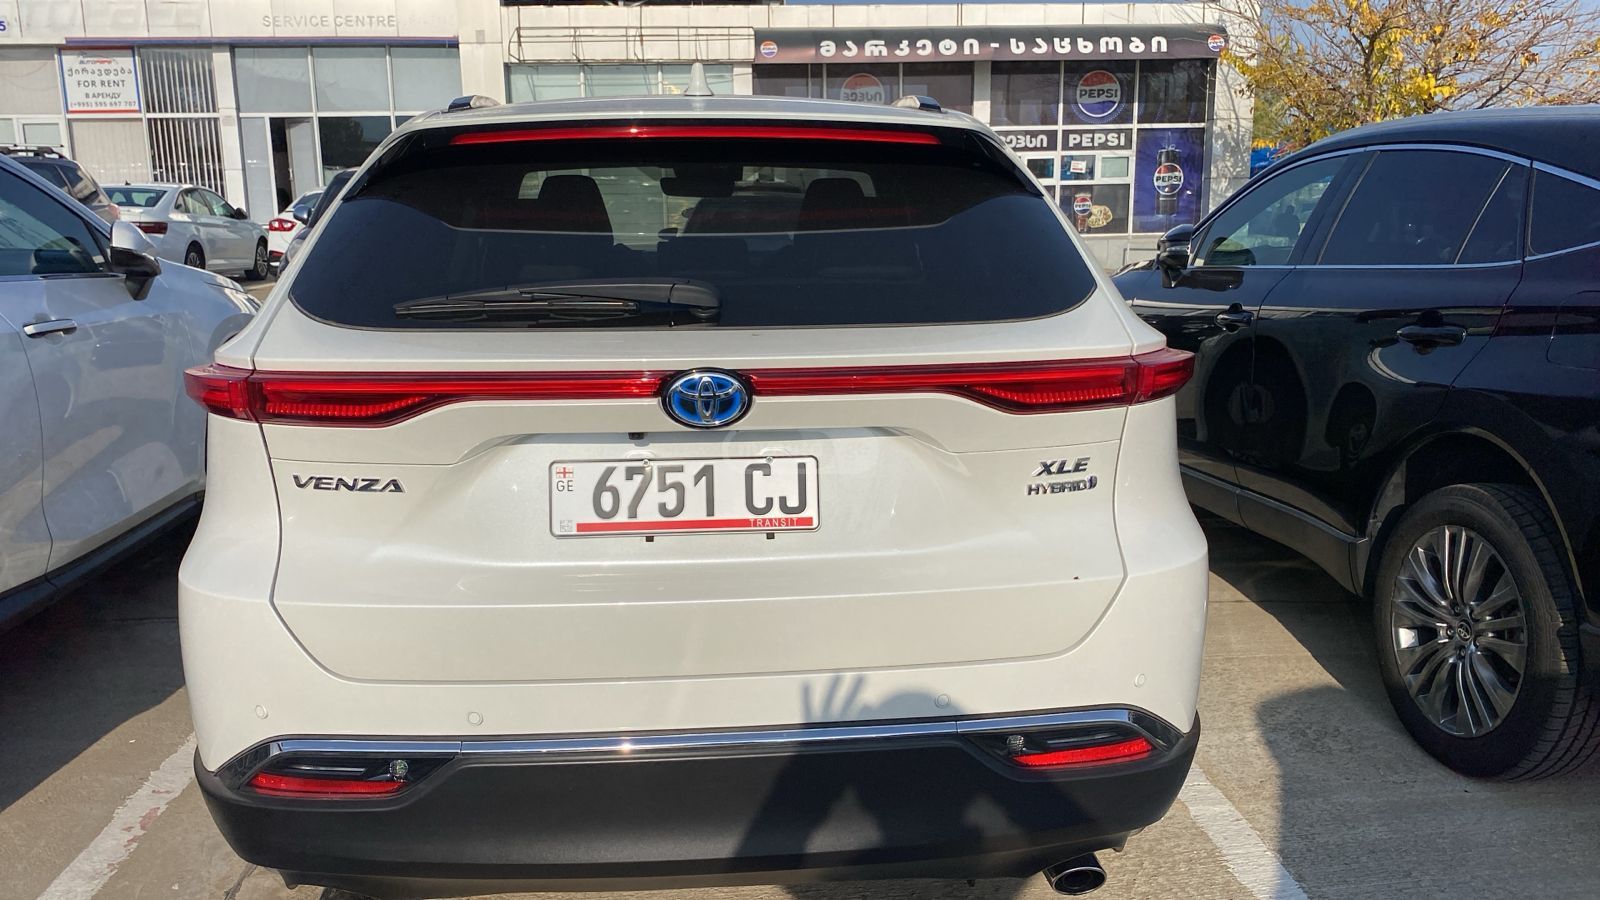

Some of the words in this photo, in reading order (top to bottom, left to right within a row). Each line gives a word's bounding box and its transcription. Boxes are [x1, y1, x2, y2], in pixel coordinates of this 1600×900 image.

[262, 14, 330, 28] SERVICE
[333, 14, 397, 28] CENTRE
[819, 37, 980, 57] მარკეტი
[1009, 35, 1168, 54] საცხობი
[67, 66, 133, 77] ქირავდება
[77, 80, 97, 88] FOR
[100, 79, 126, 88] RENT
[92, 92, 121, 100] АРЕНДУ
[1079, 87, 1119, 99] PEPSI
[1068, 132, 1126, 148] PEPSI
[1155, 175, 1182, 183] PEPSI
[1031, 457, 1091, 477] XLE
[292, 474, 405, 493] VENZA
[556, 480, 574, 492] GE
[592, 464, 715, 519] 6751
[744, 461, 808, 516] CJ
[1025, 479, 1088, 496] HYBRID
[750, 516, 799, 528] TRANSIT
